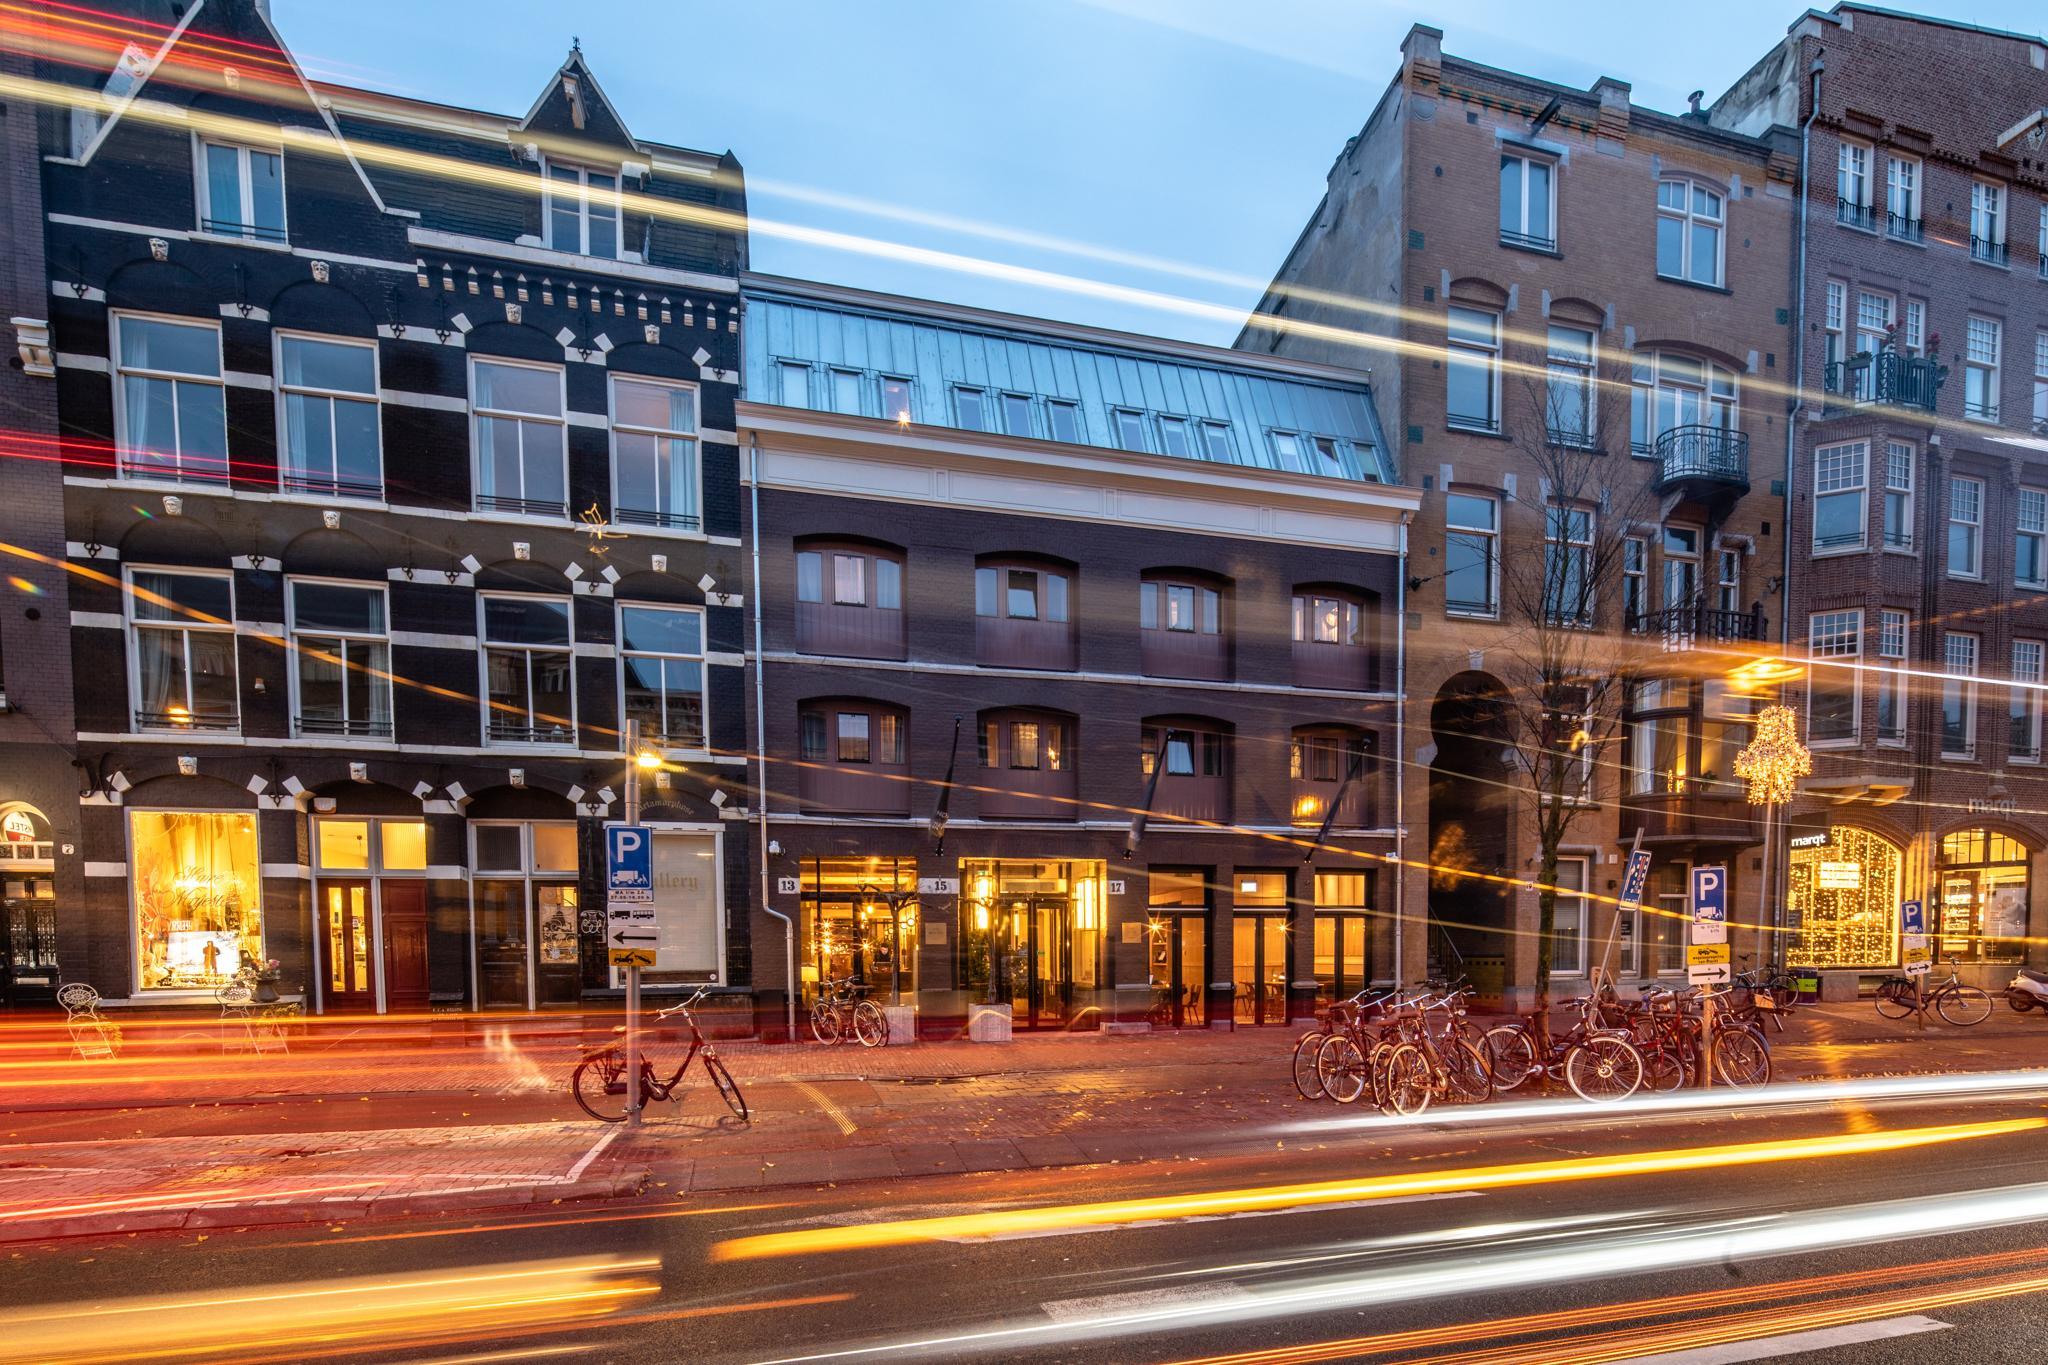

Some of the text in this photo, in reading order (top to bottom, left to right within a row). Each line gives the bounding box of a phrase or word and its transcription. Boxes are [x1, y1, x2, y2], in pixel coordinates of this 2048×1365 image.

[1969, 797, 2017, 821] marqt
[616, 831, 641, 863] P
[1791, 834, 1826, 846] marqt
[781, 880, 796, 891] 13
[934, 880, 948, 891] 15
[1111, 883, 1121, 892] 17
[1700, 872, 1719, 901] P
[1905, 904, 1918, 923] P
